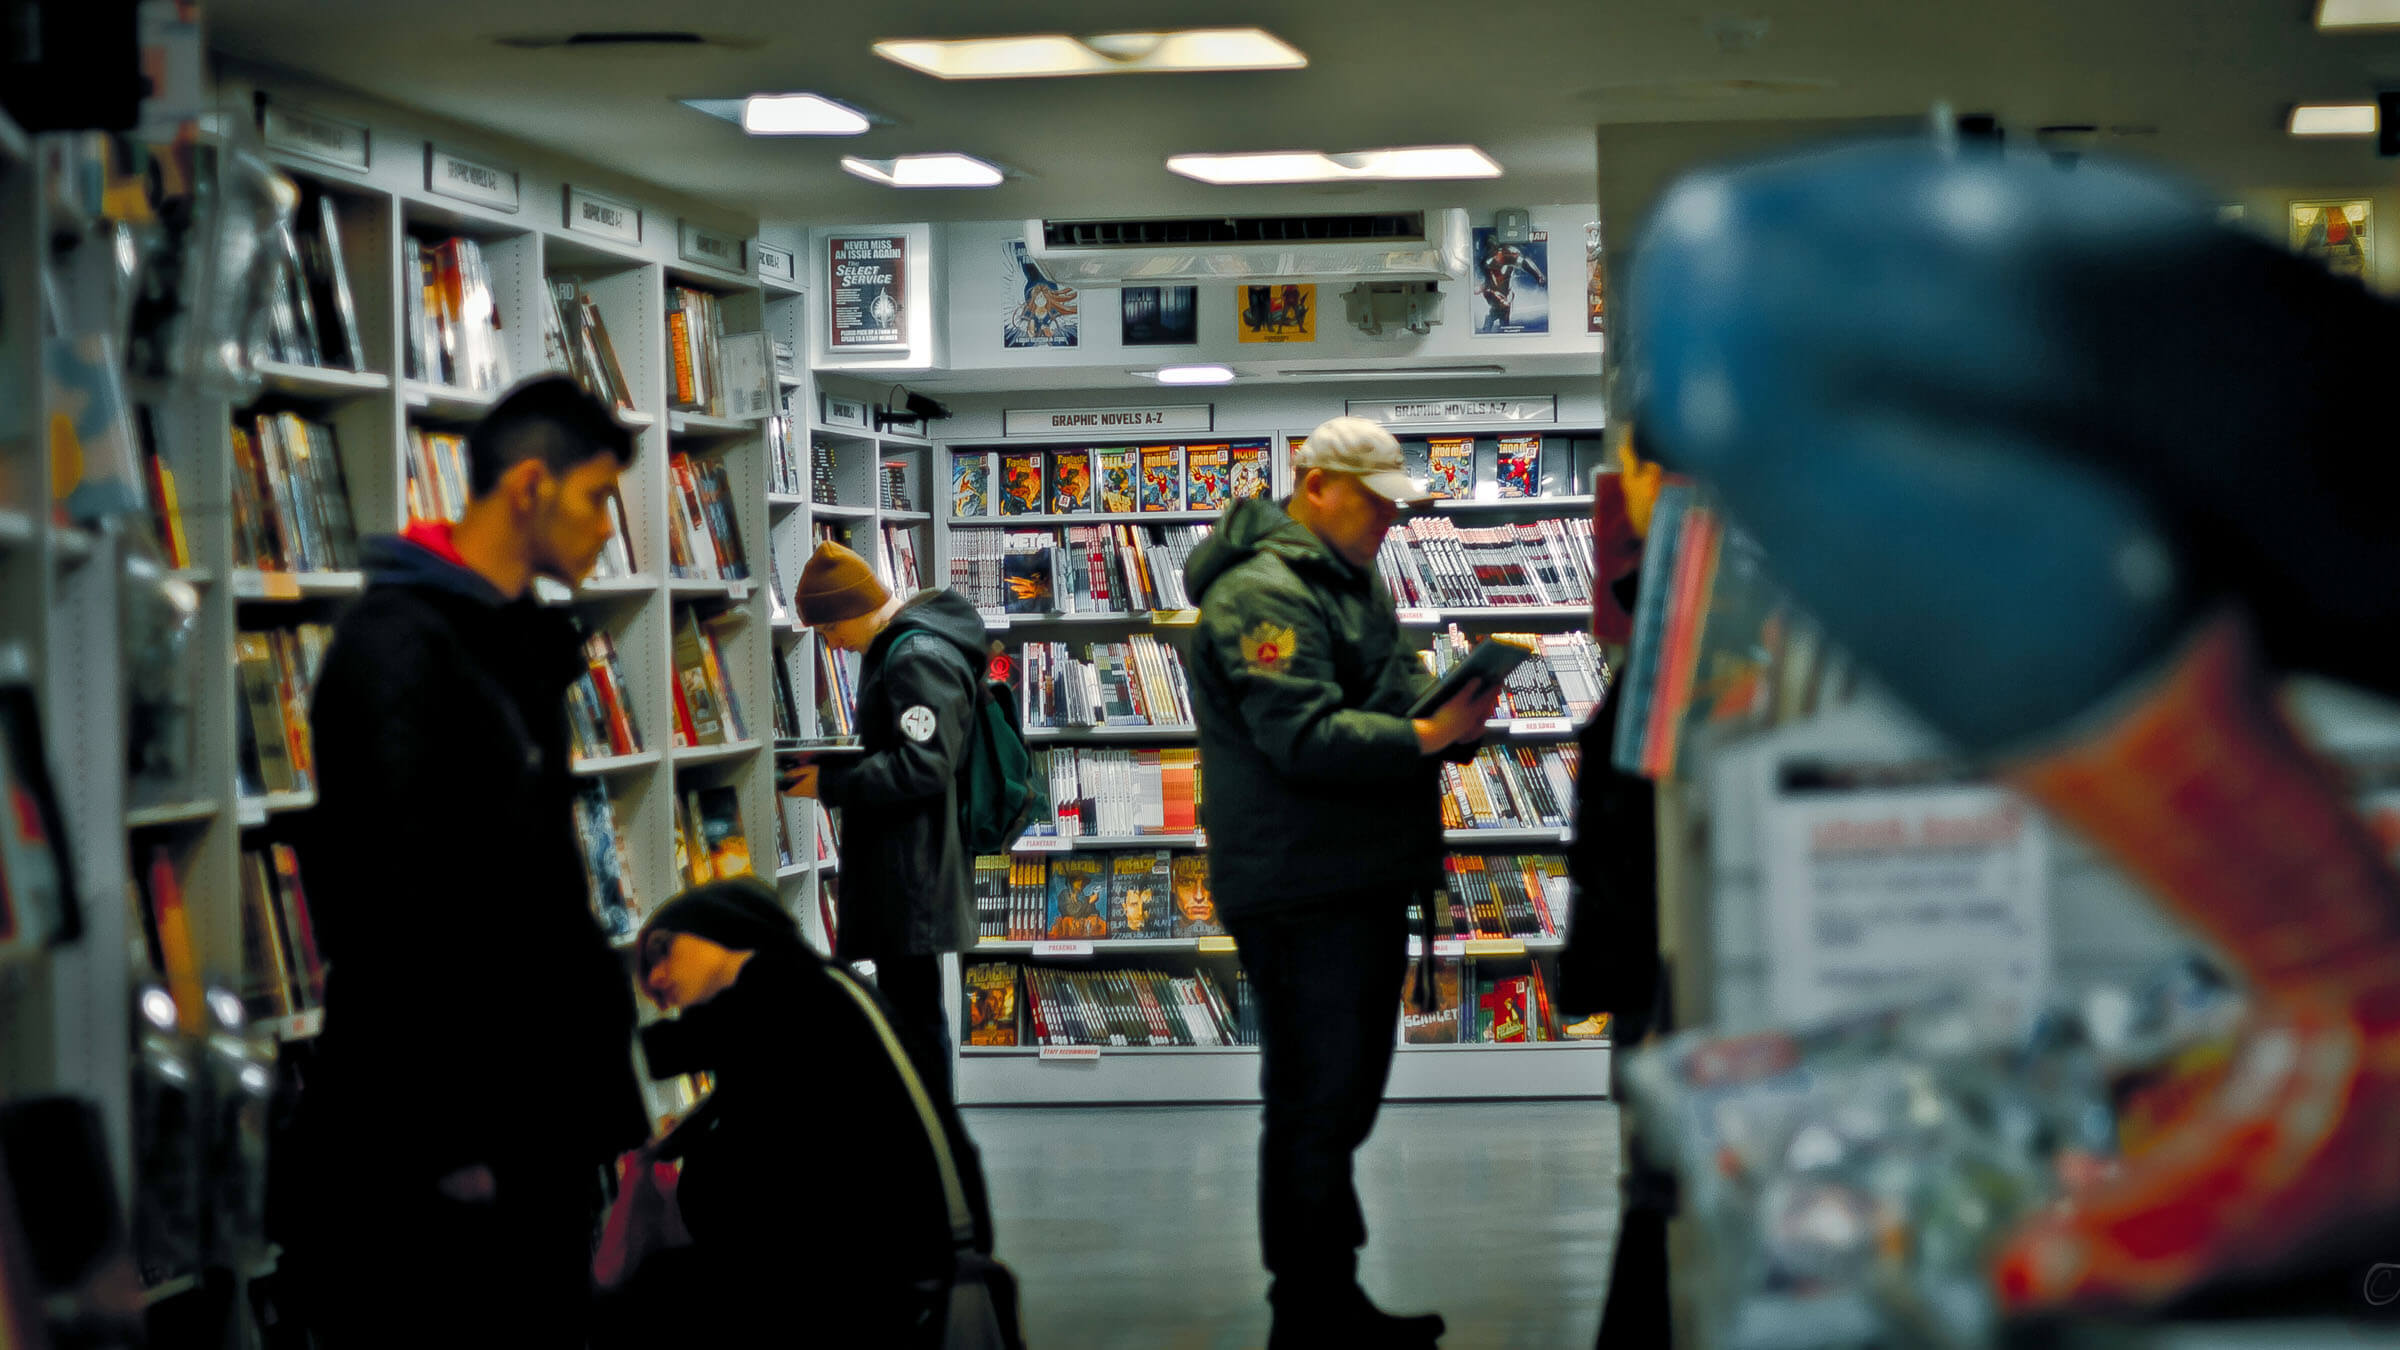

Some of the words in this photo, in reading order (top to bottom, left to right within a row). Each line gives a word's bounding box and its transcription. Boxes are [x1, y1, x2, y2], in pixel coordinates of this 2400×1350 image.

[844, 241, 869, 250] NEVER
[870, 240, 892, 249] MISS
[835, 251, 846, 259] AN
[848, 249, 871, 259] ISSUE
[873, 248, 901, 258] AGAIN!
[1395, 404, 1440, 416] GRAPHIC
[1444, 402, 1486, 415] NOVELS
[1488, 402, 1507, 414] A-Z
[1052, 414, 1098, 427] GRAPHIC
[1101, 412, 1142, 425] NOVELS
[1145, 412, 1162, 424] A-Z
[1004, 533, 1057, 548] METAL
